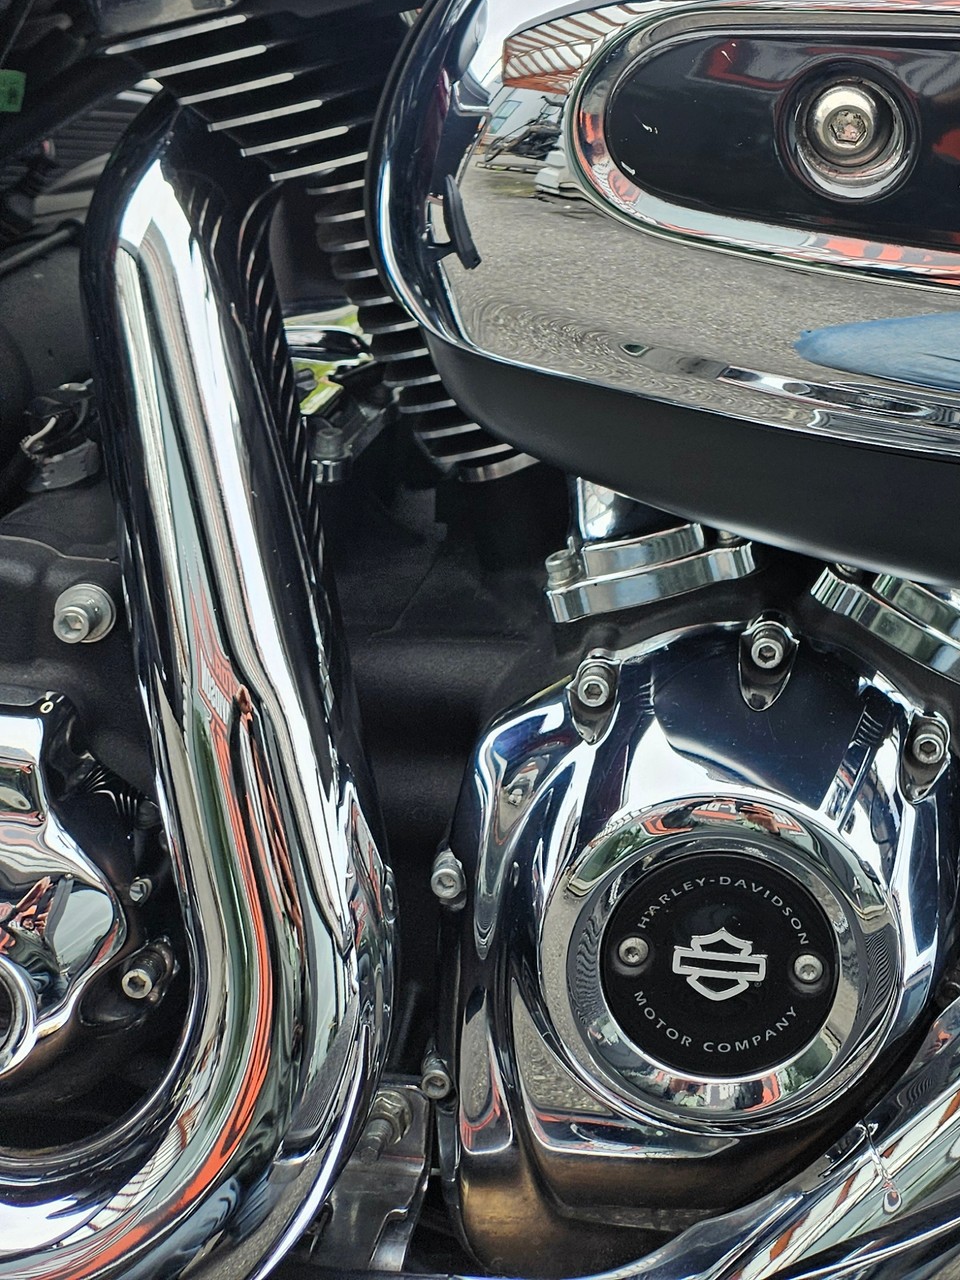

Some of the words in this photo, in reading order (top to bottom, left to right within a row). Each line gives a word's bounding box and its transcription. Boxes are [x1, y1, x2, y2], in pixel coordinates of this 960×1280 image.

[638, 876, 809, 945] HARLEY-DAVIDSON
[634, 991, 692, 1047] MOTOR
[703, 1006, 798, 1053] COMPANY
